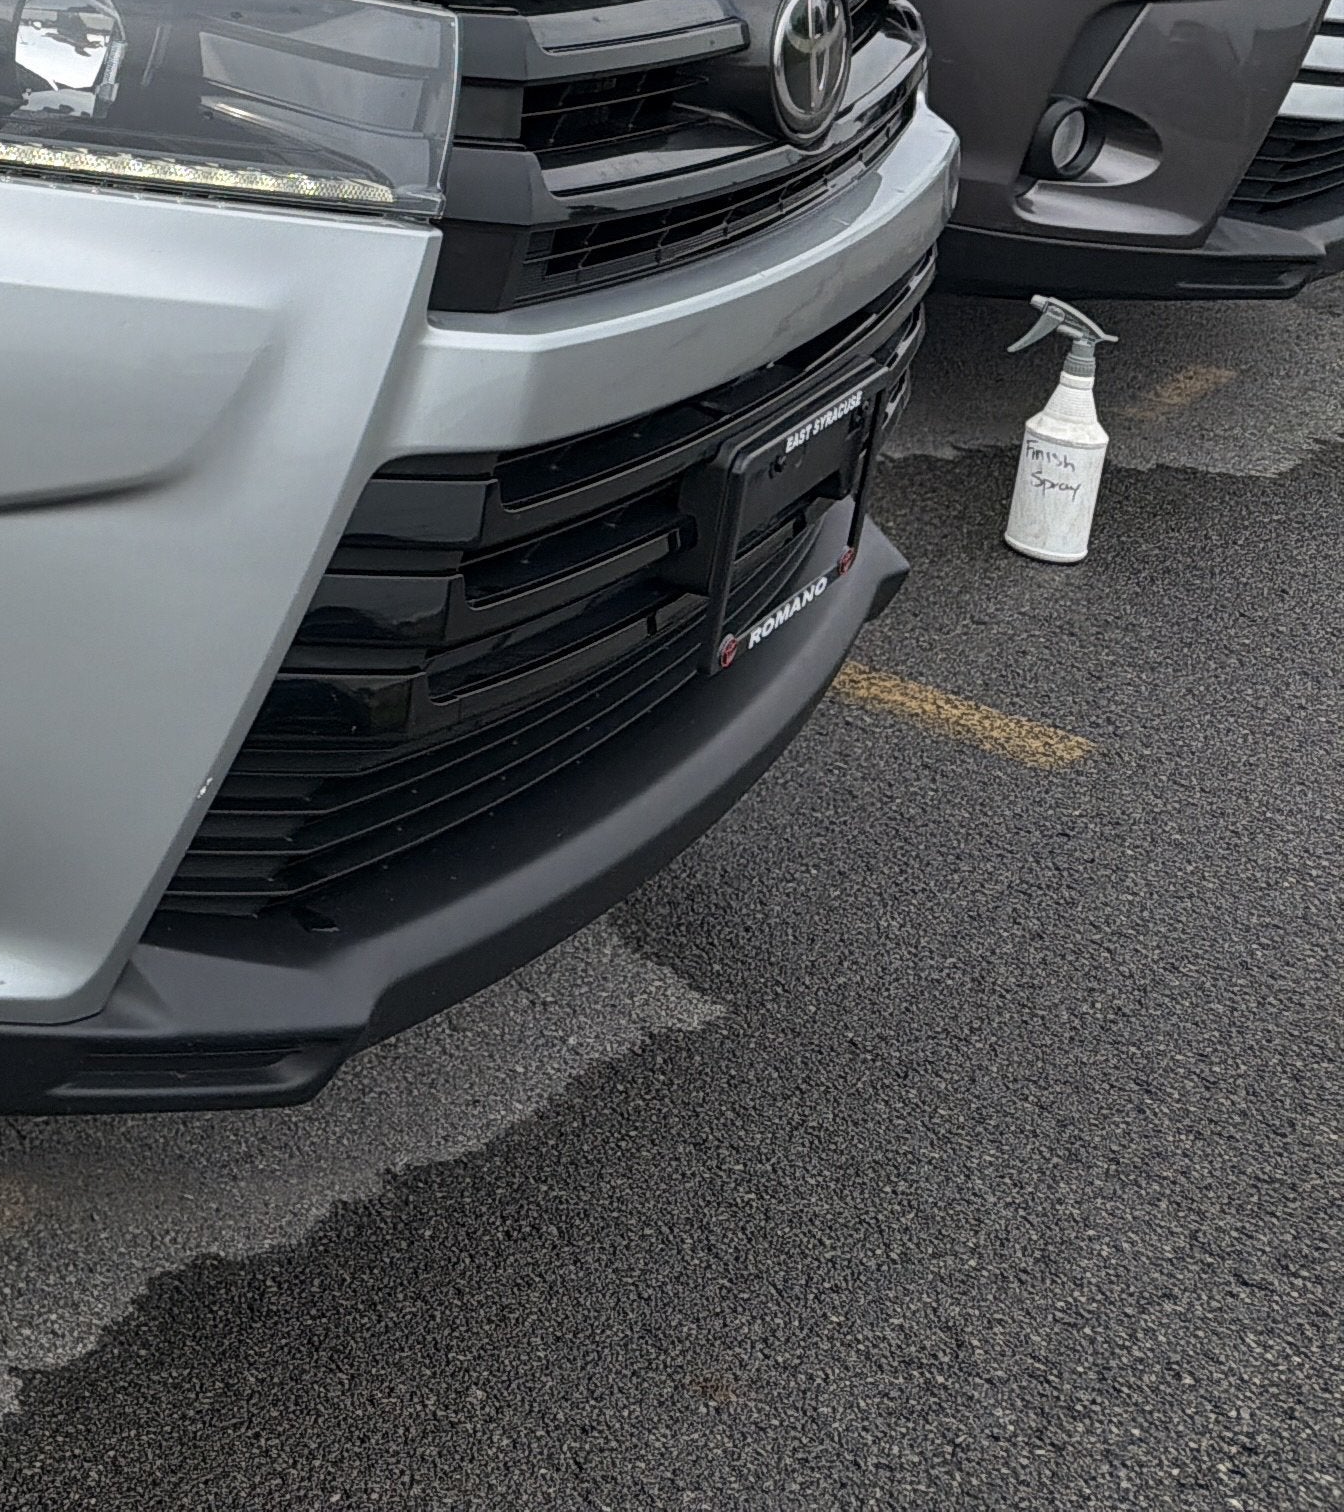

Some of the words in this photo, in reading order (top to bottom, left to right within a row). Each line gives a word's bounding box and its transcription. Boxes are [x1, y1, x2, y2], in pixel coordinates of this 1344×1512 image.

[785, 423, 813, 454] EAST
[812, 390, 863, 436] SYRACUSE
[1025, 439, 1076, 473] Finish
[1030, 470, 1081, 503] Spray
[747, 576, 828, 650] ROMANO
